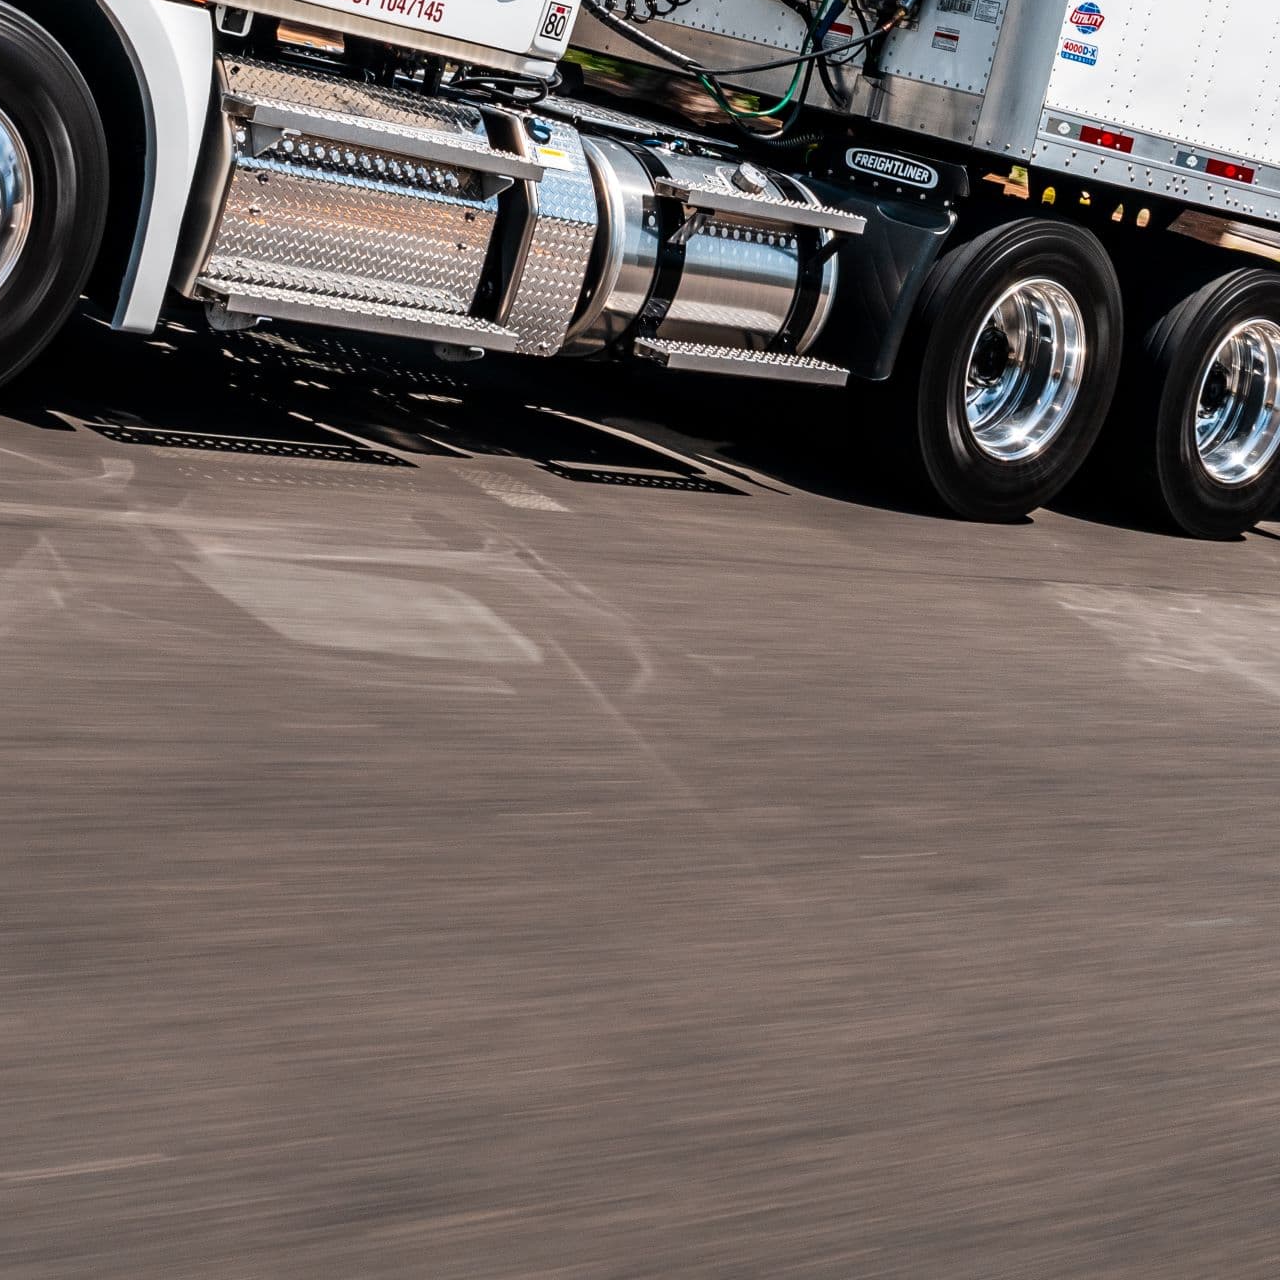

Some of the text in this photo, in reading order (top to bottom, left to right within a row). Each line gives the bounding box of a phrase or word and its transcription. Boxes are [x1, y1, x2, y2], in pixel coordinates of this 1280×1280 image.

[544, 12, 566, 37] 80
[1071, 12, 1104, 27] UTILITY
[1063, 41, 1097, 58] 4000D-X
[854, 152, 930, 183] FREIGHTLINER
